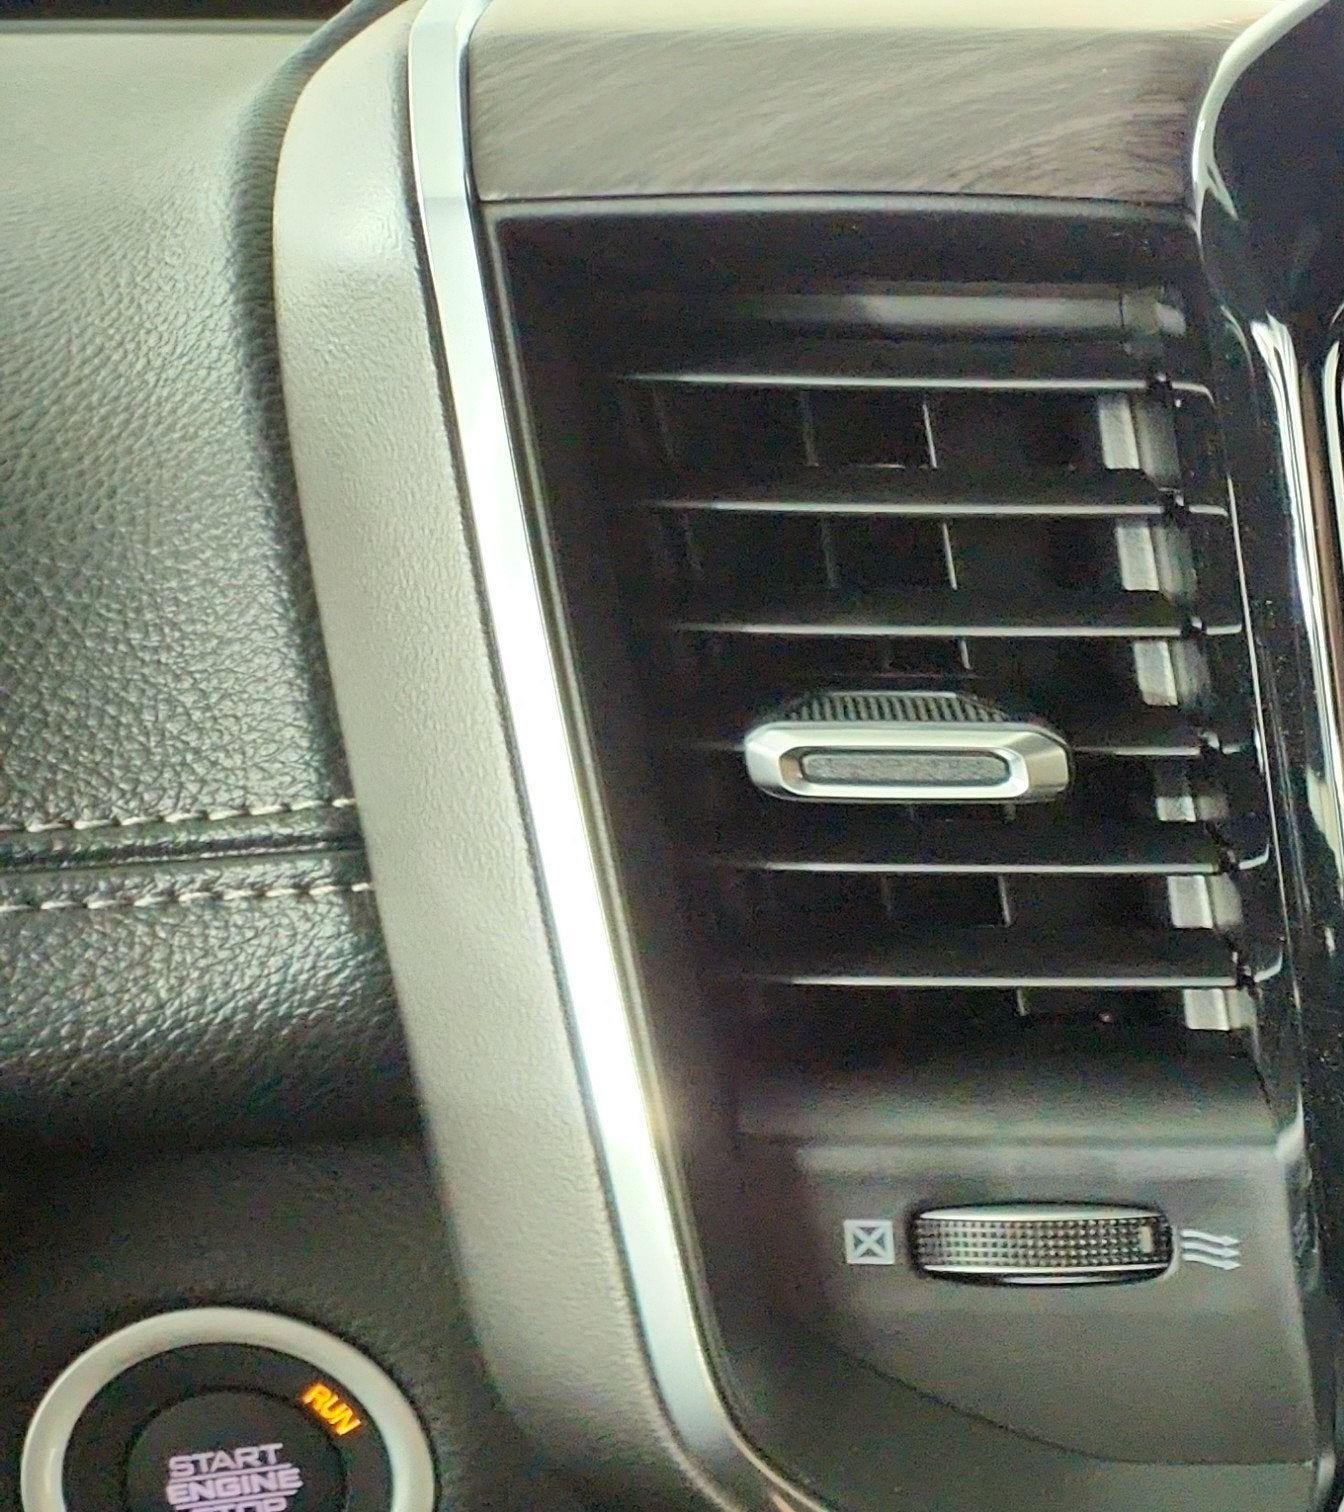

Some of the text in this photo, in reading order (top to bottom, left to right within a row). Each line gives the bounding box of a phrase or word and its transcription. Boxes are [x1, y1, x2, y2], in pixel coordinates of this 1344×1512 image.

[303, 1382, 361, 1436] RUN
[168, 1442, 284, 1477] START
[166, 1469, 303, 1505] ENGINE
